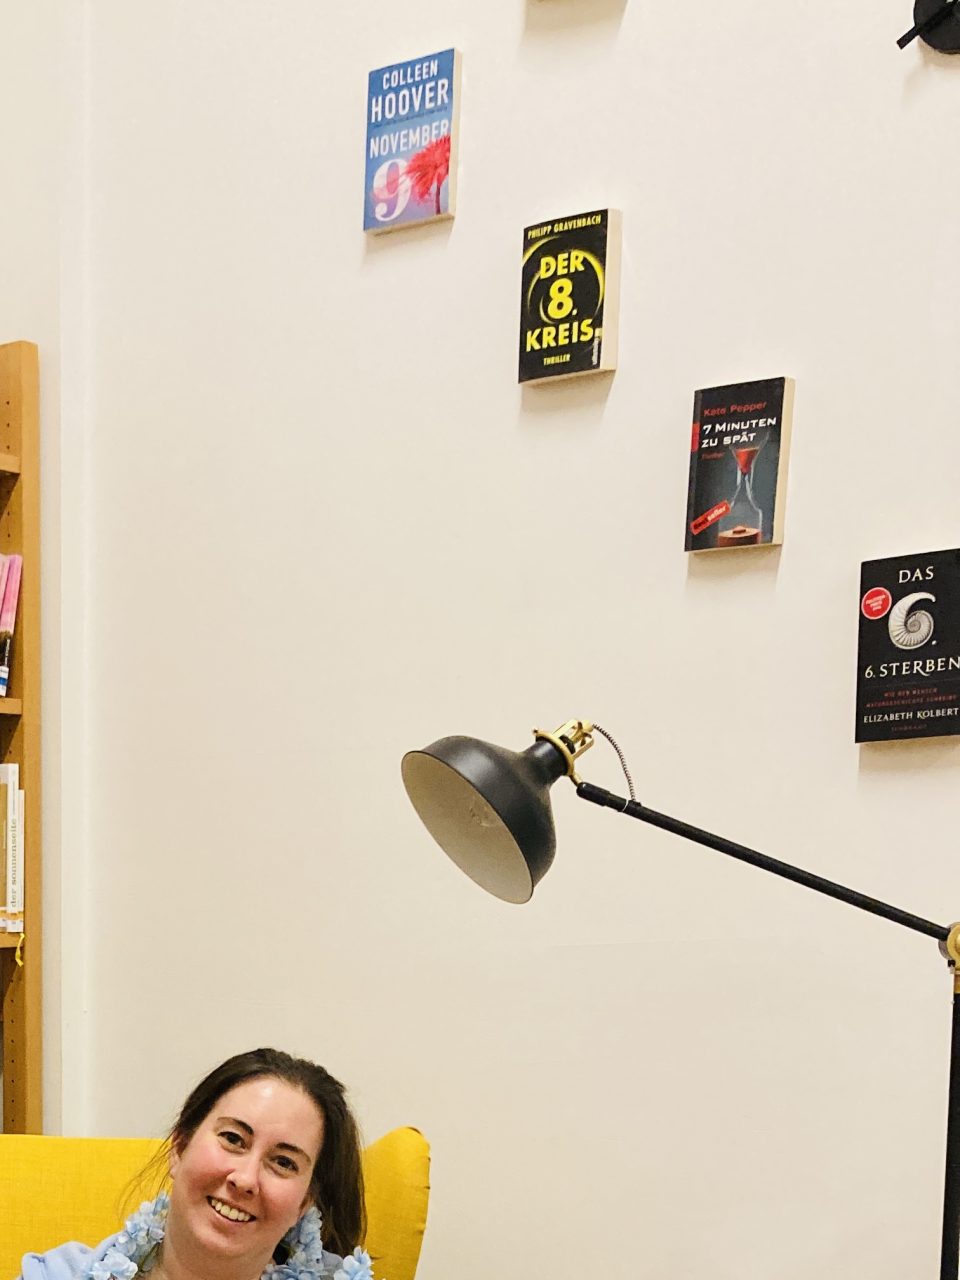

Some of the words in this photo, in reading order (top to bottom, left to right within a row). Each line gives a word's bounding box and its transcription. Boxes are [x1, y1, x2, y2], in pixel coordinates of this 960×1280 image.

[383, 59, 439, 89] COLLEEN
[371, 78, 450, 123] HOOVER
[370, 119, 452, 159] NOVEMBER
[373, 159, 412, 222] 9
[528, 225, 552, 240] PHILIPP
[554, 214, 602, 234] GRAVENBACH
[540, 250, 585, 280] DER
[526, 319, 594, 352] KREIS
[543, 353, 571, 366] THRILLER
[730, 401, 768, 414] Pepper
[702, 424, 713, 436] 7
[898, 566, 935, 584] DAS
[864, 665, 877, 679] 6.
[879, 656, 960, 678] STERBEN
[863, 711, 913, 724] ELIZABETH
[916, 707, 959, 720] KOLBERT
